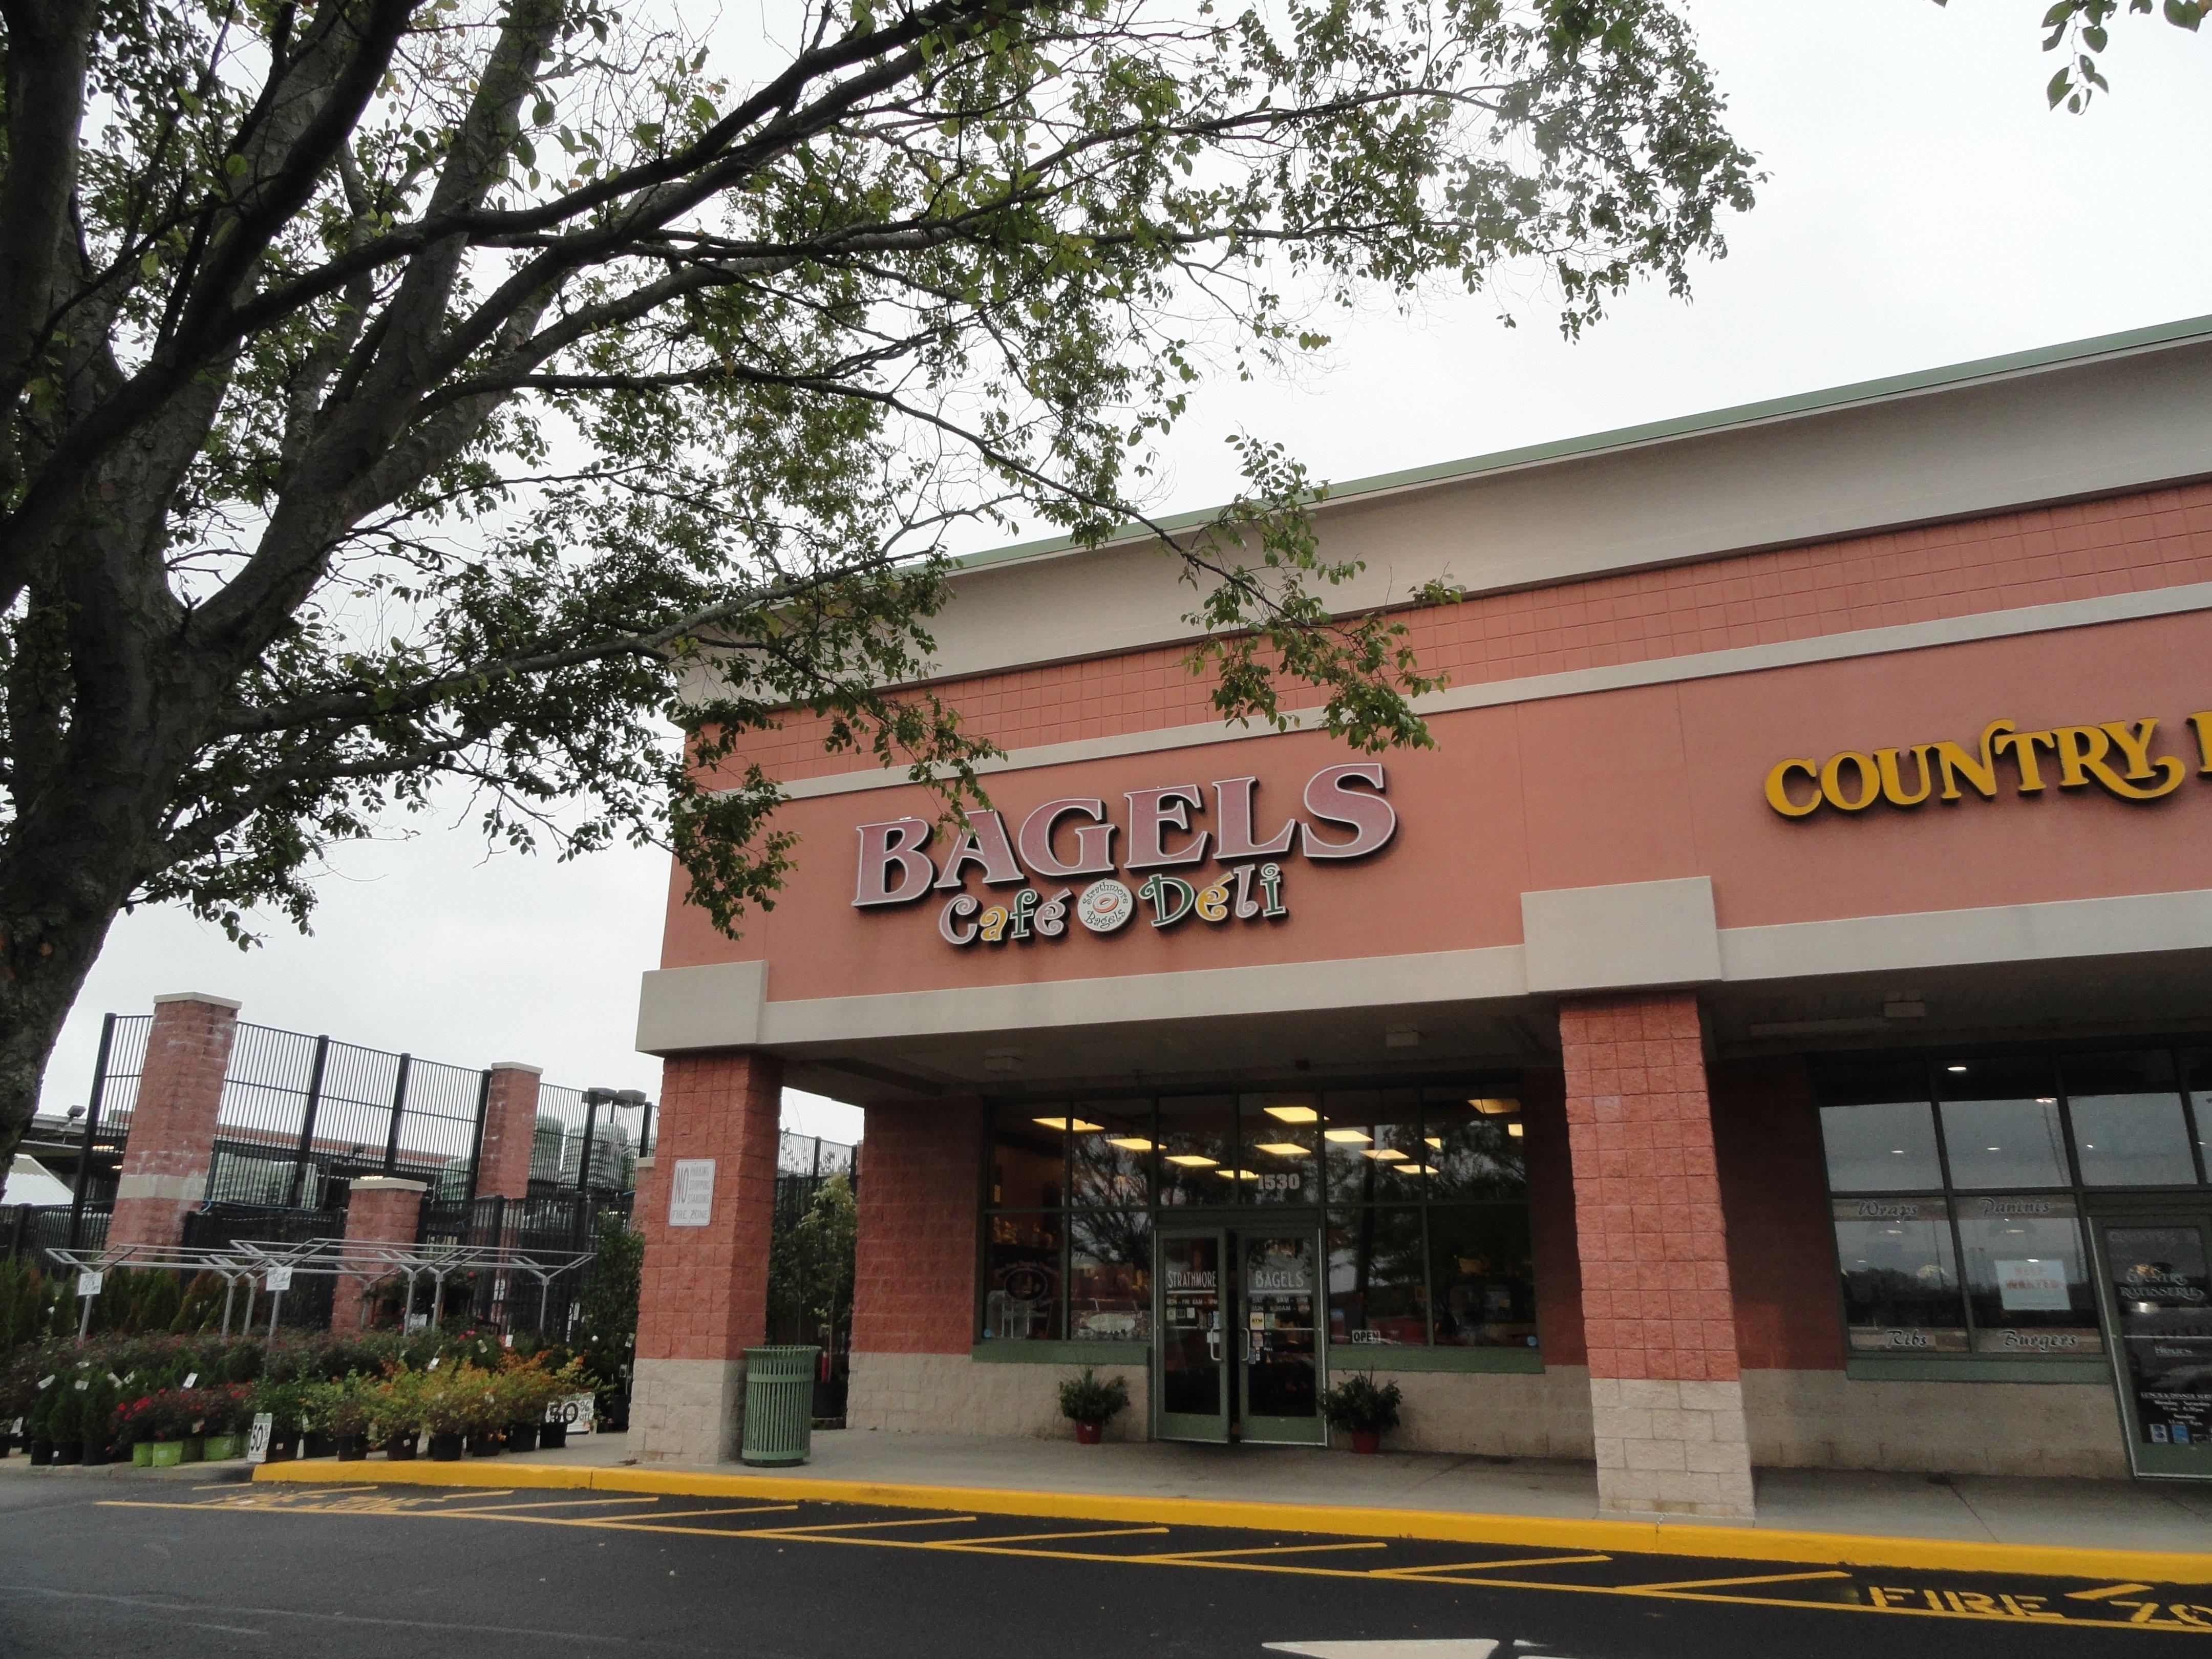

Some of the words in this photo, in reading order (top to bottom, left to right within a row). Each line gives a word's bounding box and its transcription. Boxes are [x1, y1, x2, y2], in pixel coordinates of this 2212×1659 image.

[1764, 717, 2186, 818] COUNTRY
[851, 762, 1398, 908] BAGELS
[1082, 881, 1129, 905] Strathmore
[940, 887, 1072, 945] Café
[1138, 862, 1287, 927] Déli
[1083, 909, 1125, 929] Bagels
[674, 1167, 689, 1204] NO
[1258, 1173, 1300, 1189] 1530
[672, 1209, 687, 1219] FIRE
[688, 1209, 708, 1219] ZONE
[1858, 1200, 1918, 1220] Wraps
[1981, 1198, 2049, 1217] Paninis
[1167, 1270, 1217, 1288] STRATHMORE
[1256, 1270, 1304, 1288] BAGELS
[1353, 1331, 1380, 1342] OPEN
[1887, 1329, 1927, 1348] Ribs
[1998, 1329, 2077, 1352] Burgers
[1868, 1586, 2066, 1618] FIRE
